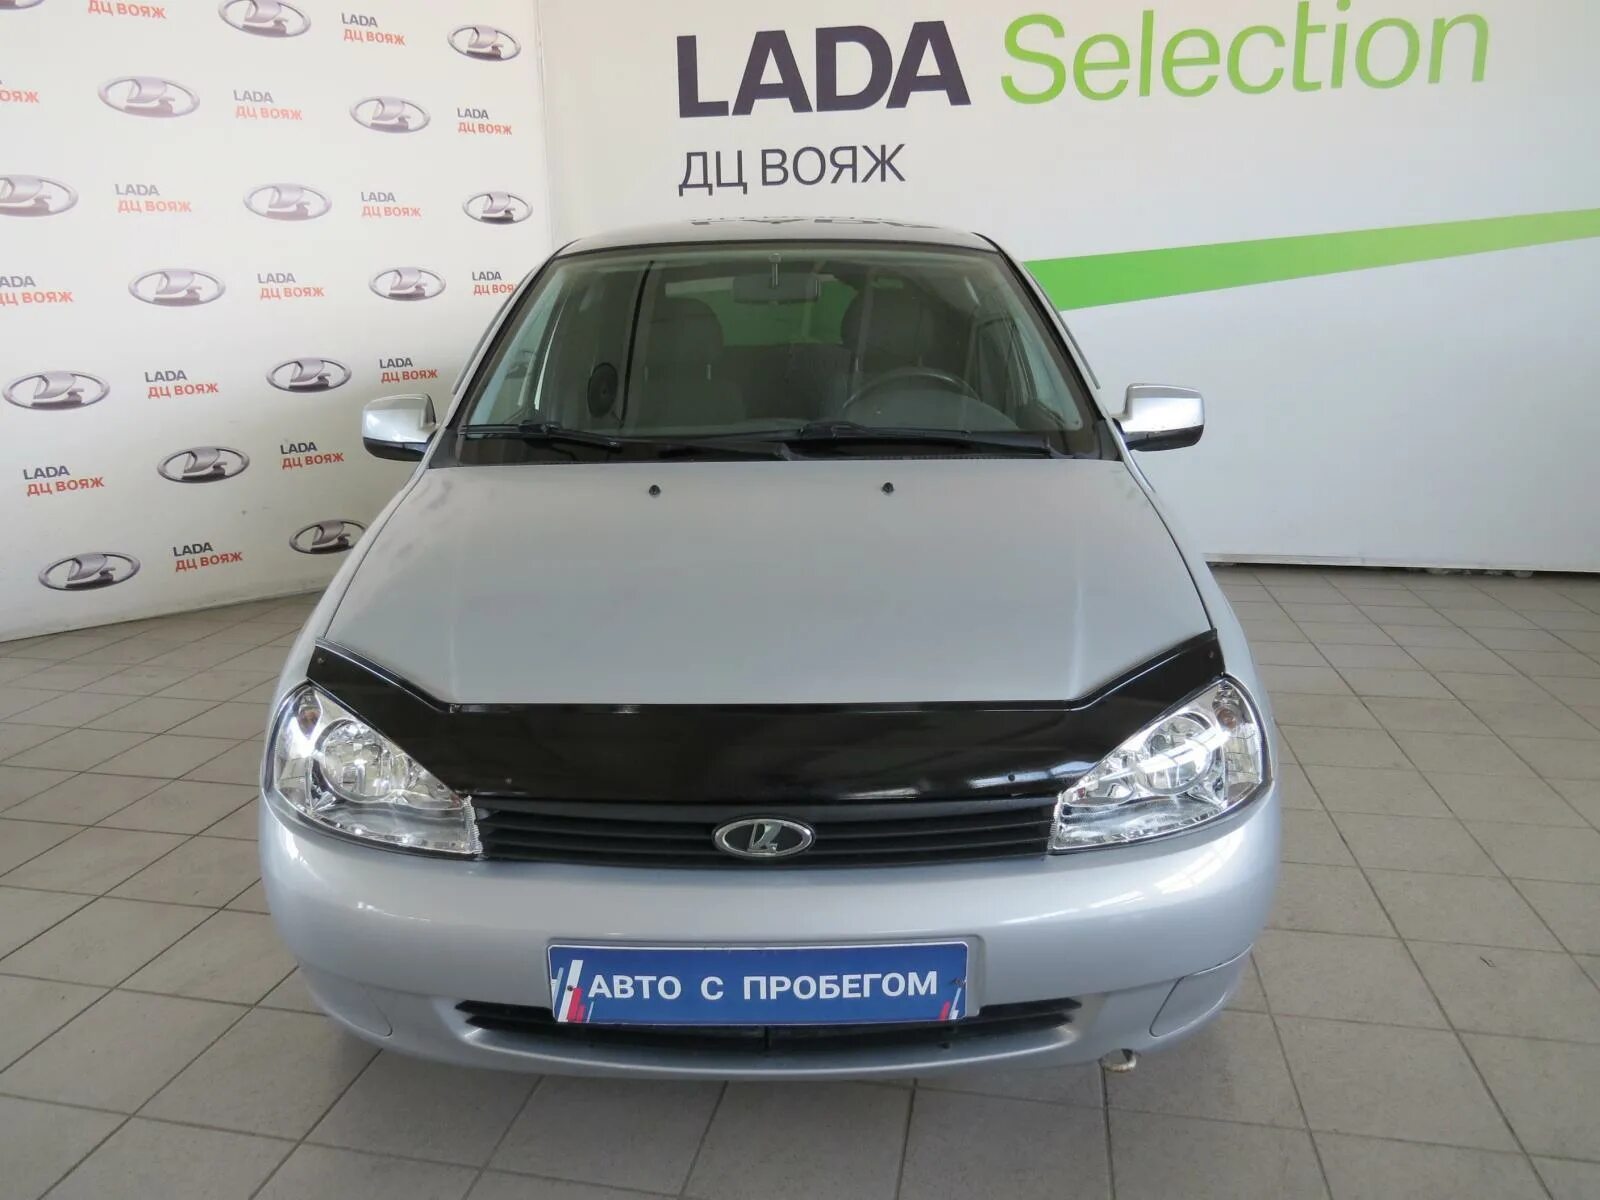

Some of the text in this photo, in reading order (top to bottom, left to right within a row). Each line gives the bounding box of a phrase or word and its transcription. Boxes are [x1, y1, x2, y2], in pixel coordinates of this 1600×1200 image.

[88, 0, 166, 19] ДЦ ВОЯЖ
[342, 13, 378, 27] LADA
[344, 29, 405, 45] ДЦ ВОЯЖ
[677, 0, 1489, 118] LADA Selection
[0, 90, 39, 103] ОЯЖ
[234, 90, 273, 103] LADA
[236, 106, 302, 120] ДЦ ВОЯЖ
[457, 108, 489, 120] LADA
[458, 122, 512, 135] ДЦ ВОЯЖ
[679, 144, 905, 196] ДЦ ВОЯЖ
[115, 184, 160, 196] LADA
[361, 192, 396, 202] LADA
[118, 200, 191, 212] ДЦ ВОЯЖ
[363, 206, 421, 217] ДЦ ВОЯЖ
[0, 276, 36, 287] ADA
[258, 273, 296, 284] LADA
[472, 272, 502, 280] LADA
[260, 287, 324, 299] ДЦ ВОЯЖ
[474, 284, 518, 295] ДЦ ВОЯ
[21, 292, 73, 303] ВОЯЖ
[380, 358, 413, 369] LADA
[145, 370, 187, 382] LADA
[381, 369, 438, 383] ДЦ ВОЯЖ
[148, 384, 219, 399] ДЦ ВОЯЖ
[280, 442, 317, 455] LADA
[282, 453, 344, 470] ДЦ ВОЯЖ
[23, 466, 70, 480] LADA
[27, 477, 104, 496] ДЦ ВОЯЖ
[173, 542, 213, 557] LADA
[176, 551, 243, 572] ДЦ ВОЯЖ
[588, 971, 937, 1000] АВТО С ПРОБЕГОМ
